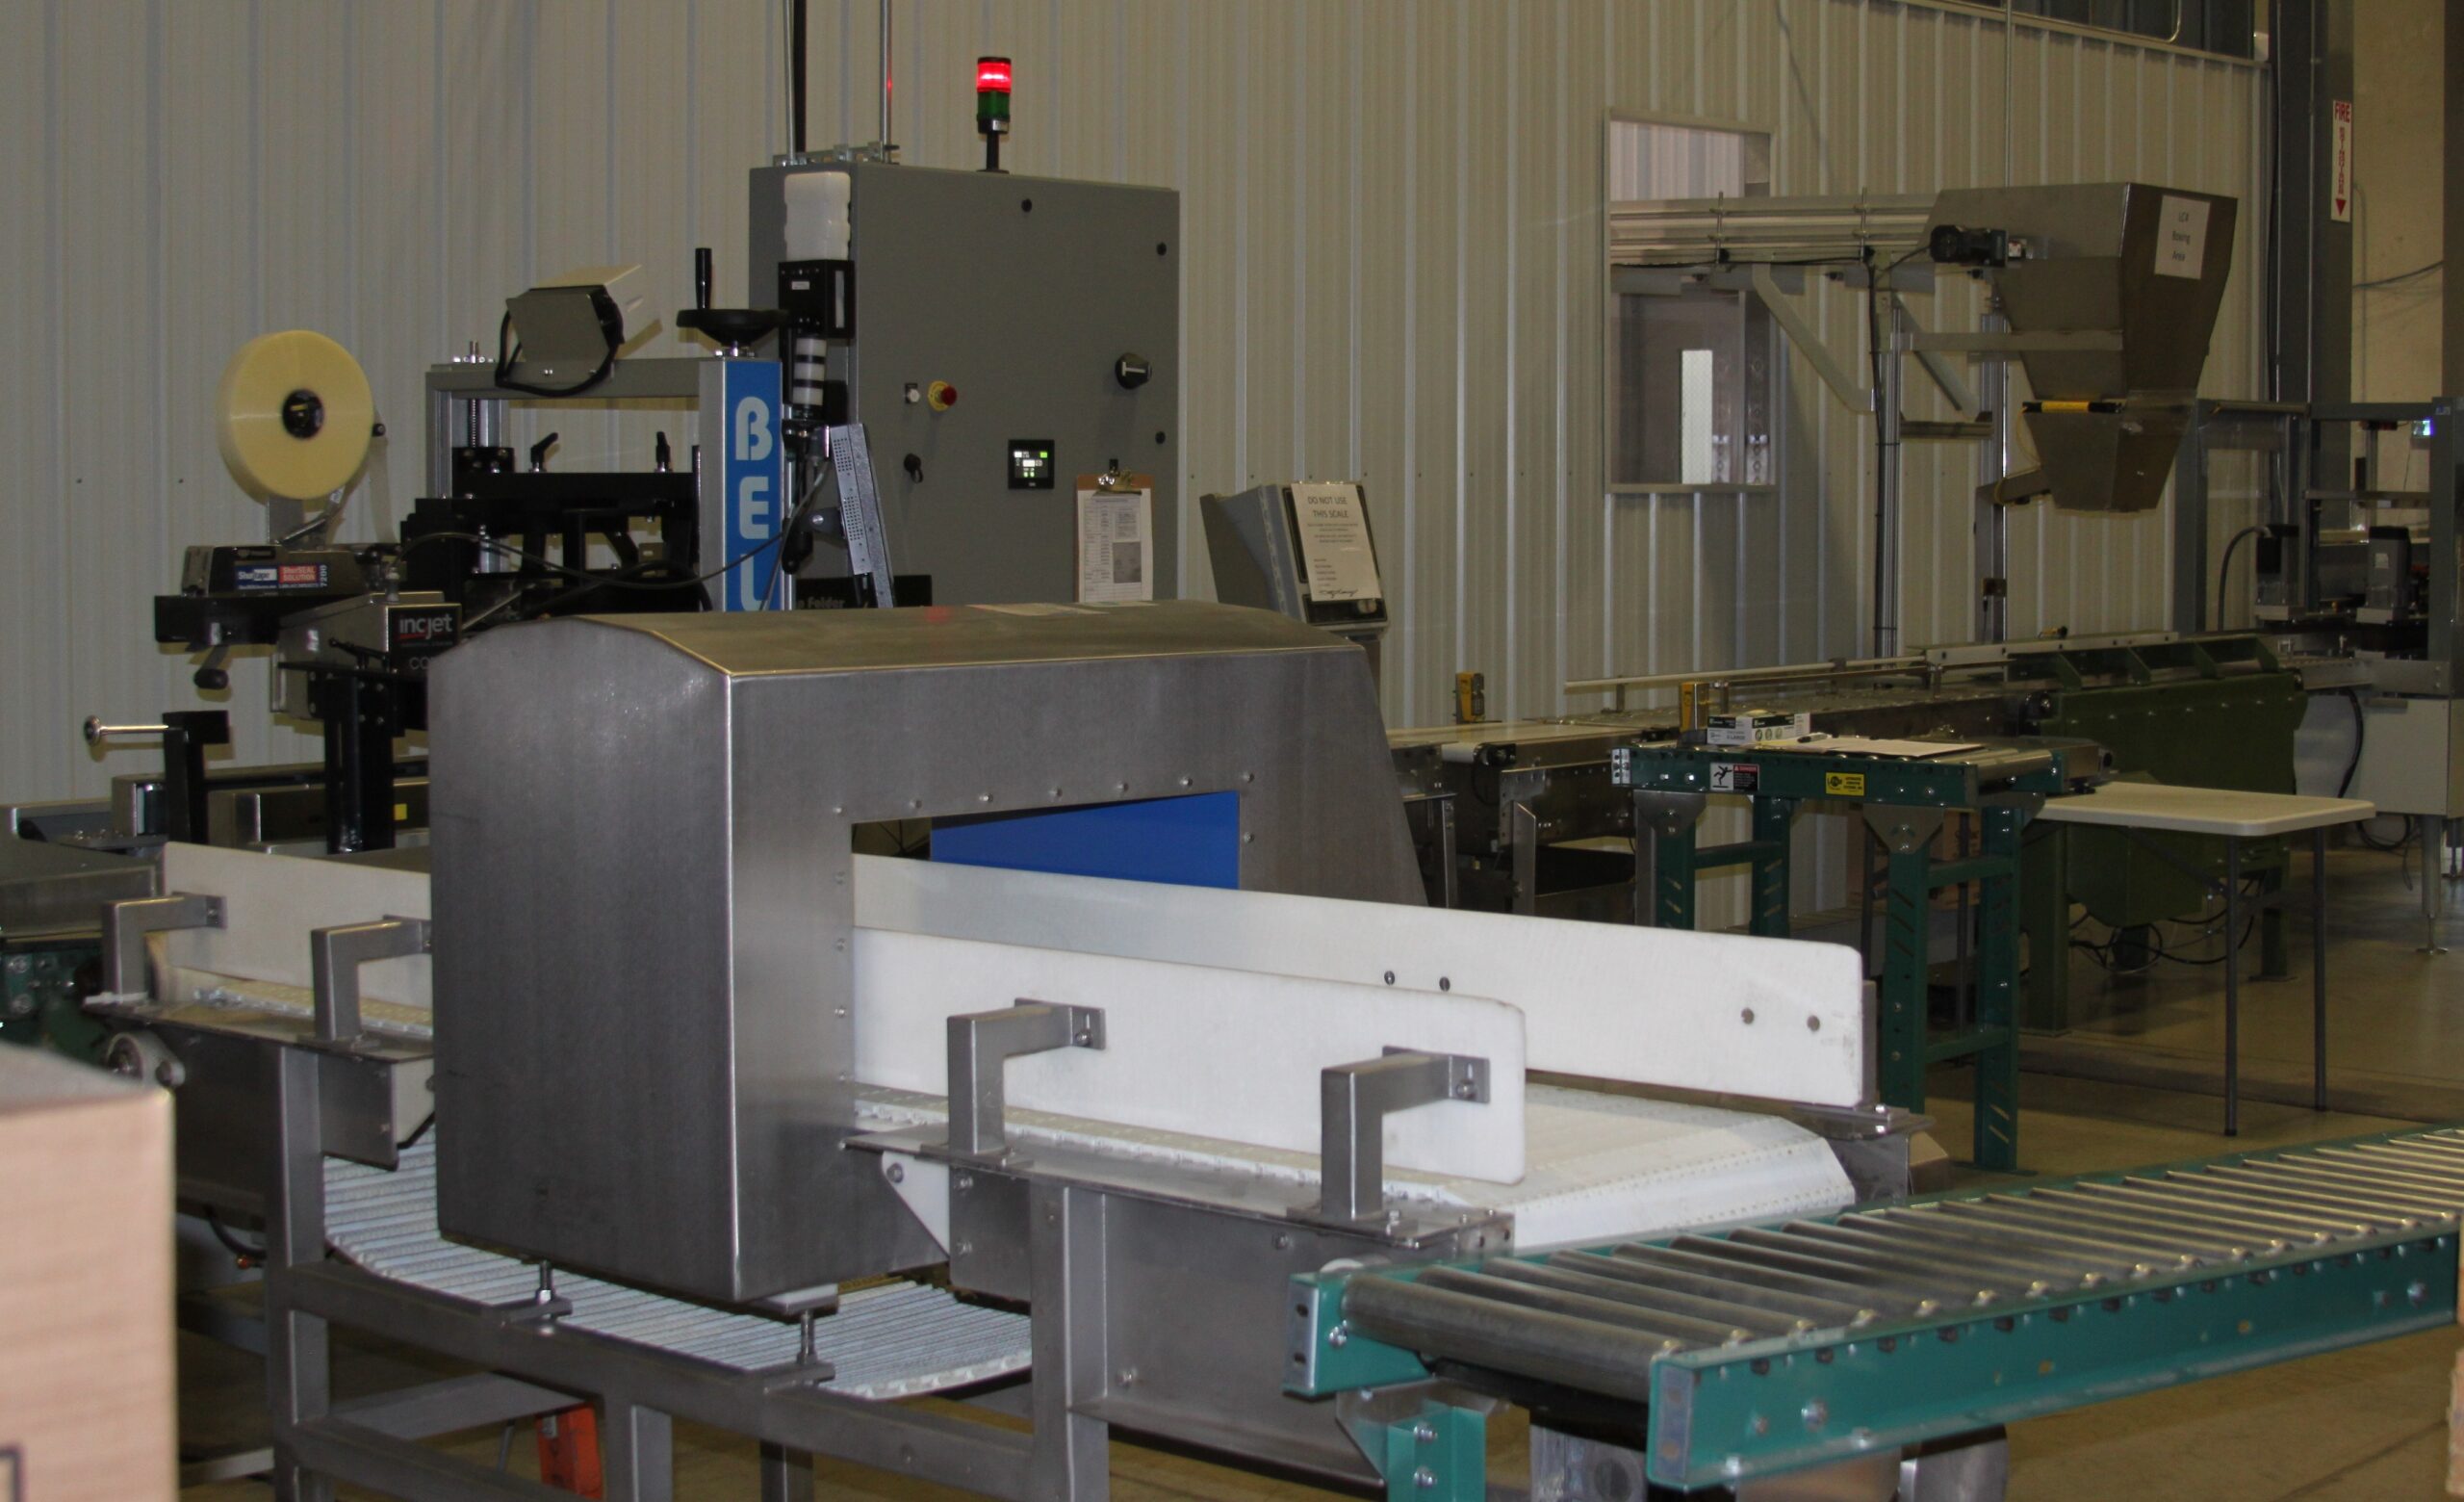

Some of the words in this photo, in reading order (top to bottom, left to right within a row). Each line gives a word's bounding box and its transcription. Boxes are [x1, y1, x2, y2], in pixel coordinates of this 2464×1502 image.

[2335, 101, 2349, 123] FIRE
[1307, 496, 1318, 505] DO
[1319, 496, 1333, 505] NOT
[1334, 496, 1348, 505] USE
[1313, 509, 1328, 518] THIS
[1328, 509, 1349, 518] SCALE
[808, 596, 845, 609] Folder
[399, 613, 453, 640] incjet
